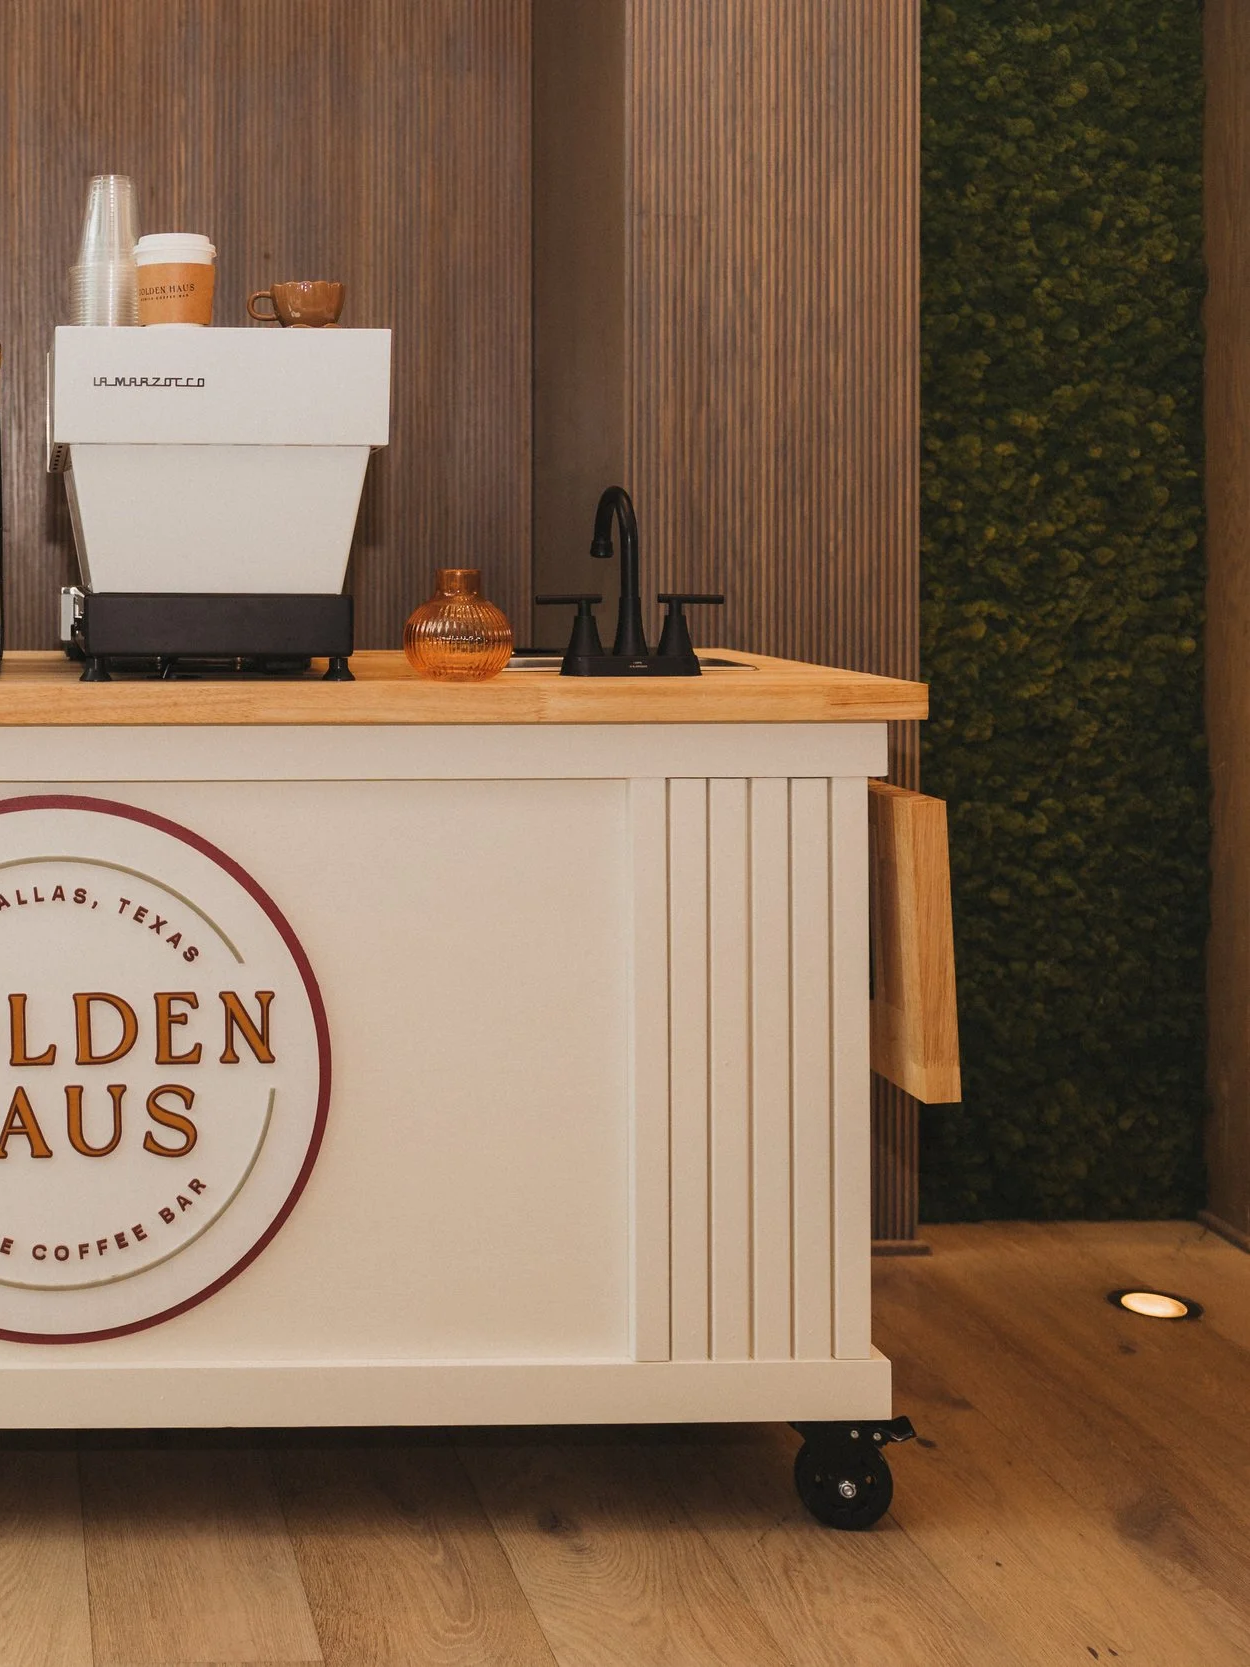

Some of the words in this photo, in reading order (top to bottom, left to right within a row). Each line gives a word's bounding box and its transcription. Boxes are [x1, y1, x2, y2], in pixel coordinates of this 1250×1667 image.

[169, 283, 195, 293] HAUS
[93, 377, 108, 387] LA
[118, 897, 200, 963] TEXAS
[31, 1223, 148, 1262] COFFEE
[157, 1178, 207, 1225] BAR
